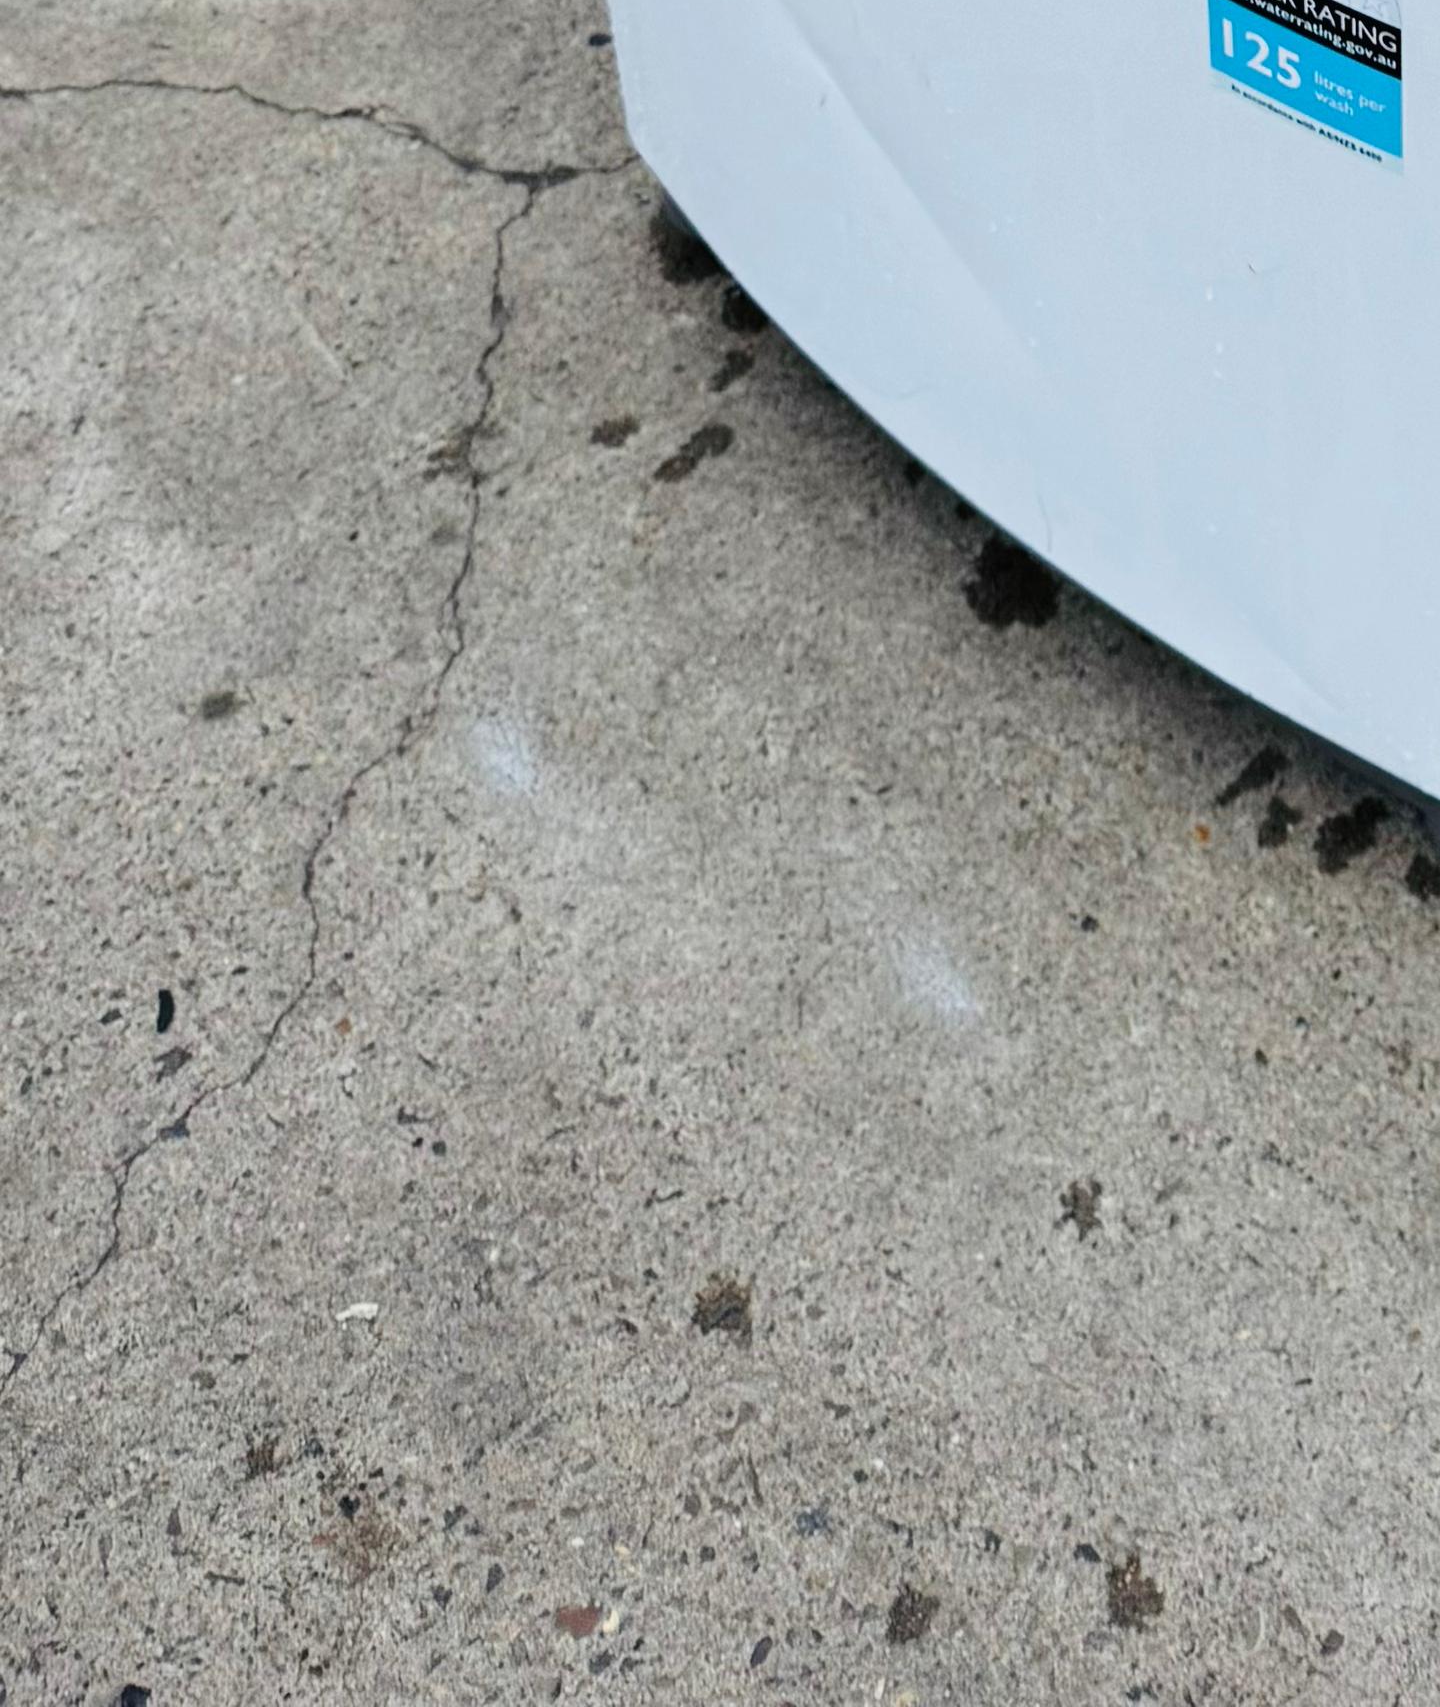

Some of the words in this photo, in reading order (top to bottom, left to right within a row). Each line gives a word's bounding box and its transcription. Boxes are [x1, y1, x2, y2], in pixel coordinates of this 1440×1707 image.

[1222, 17, 1303, 90] 125
[1314, 69, 1354, 101] litres
[1358, 93, 1388, 114] per
[1314, 90, 1354, 117] wash
